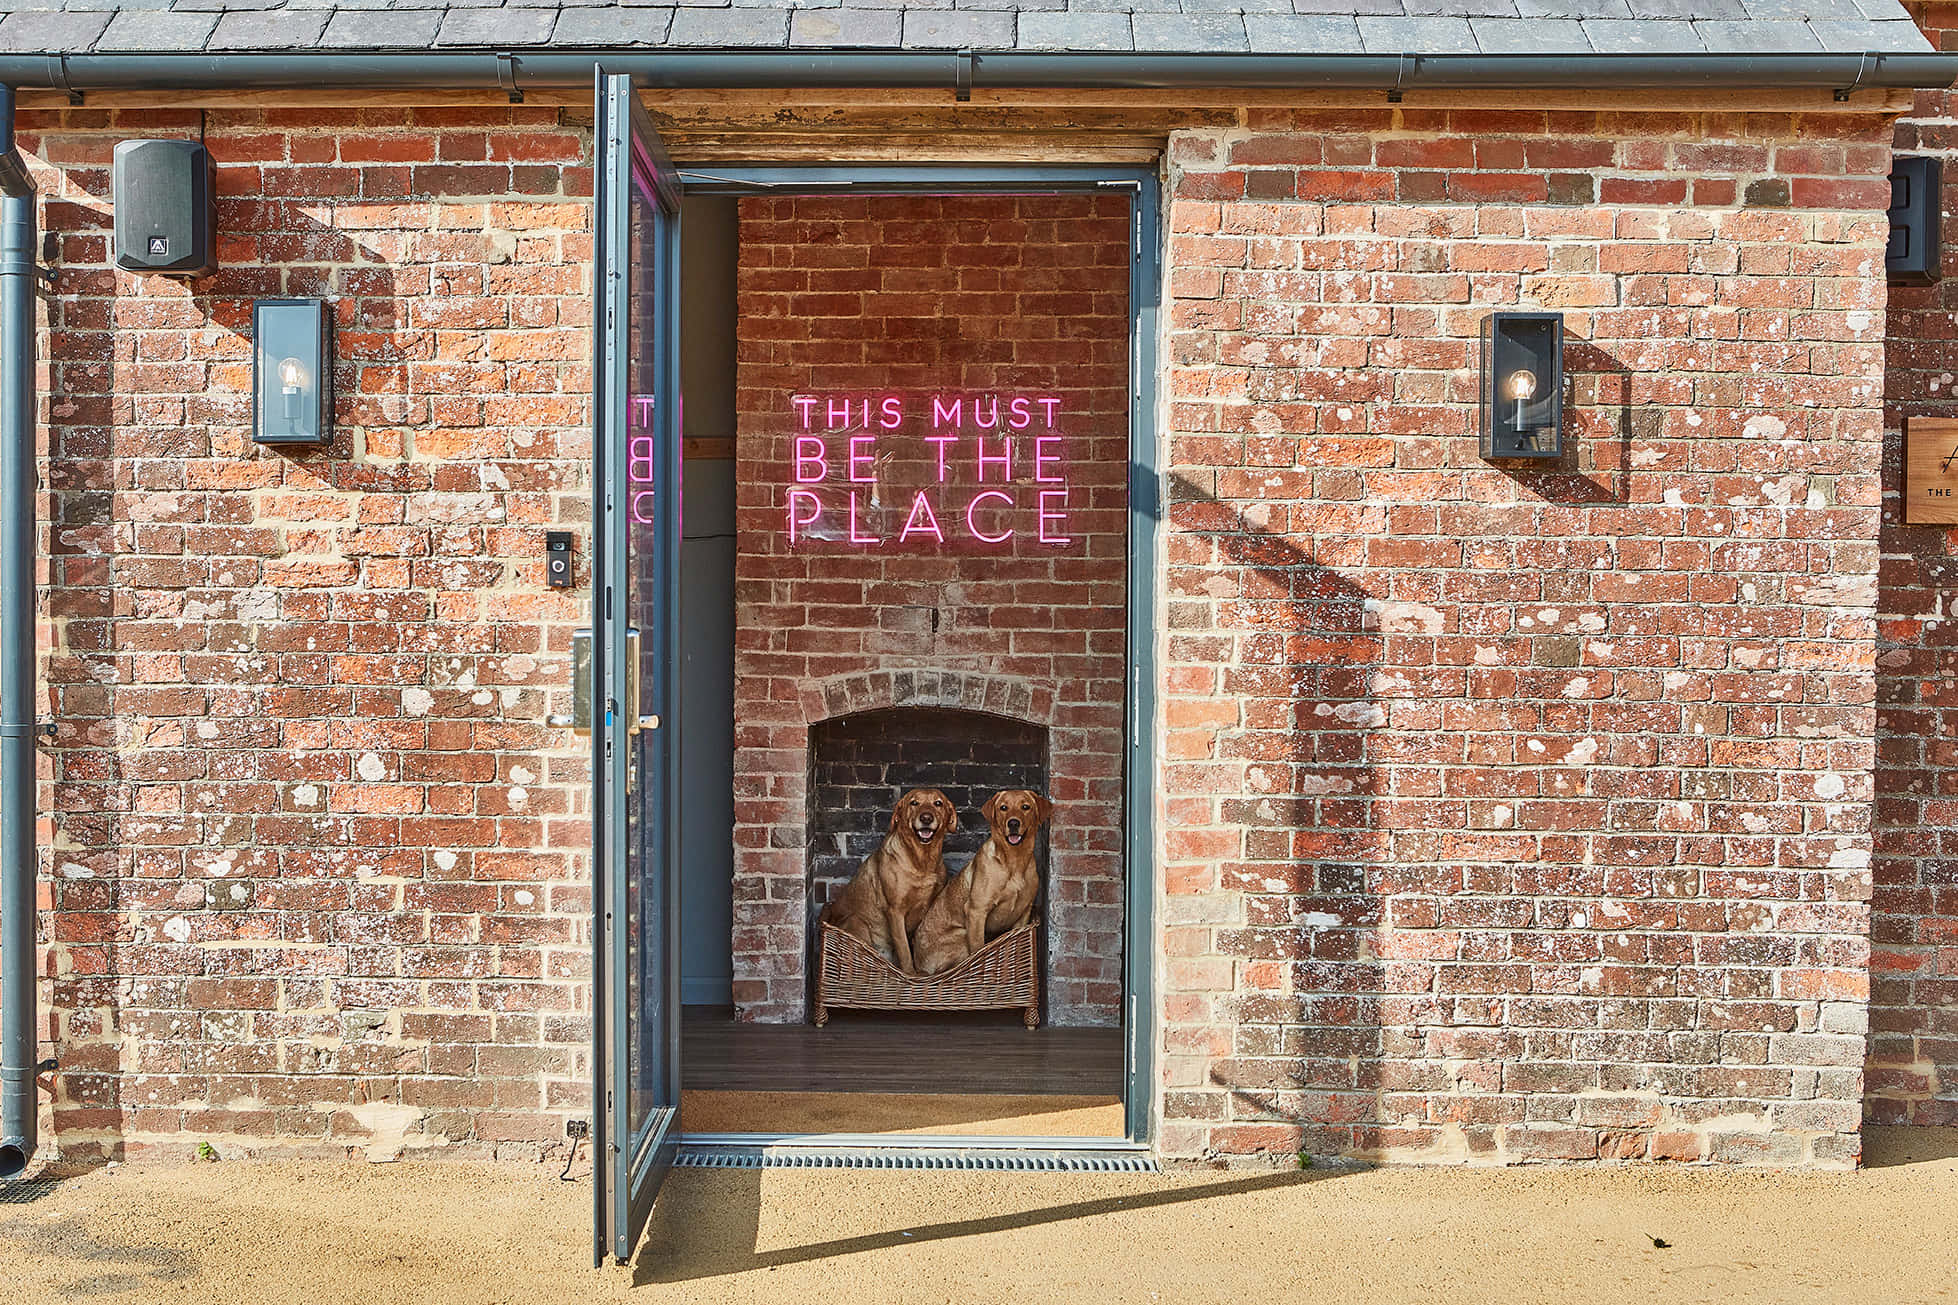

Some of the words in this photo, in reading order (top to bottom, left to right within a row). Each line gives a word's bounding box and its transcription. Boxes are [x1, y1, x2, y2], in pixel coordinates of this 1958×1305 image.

[795, 398, 901, 428] THIS
[933, 398, 1061, 428] MUST
[795, 436, 878, 482] BE
[924, 436, 1065, 482] THE
[1927, 488, 1952, 497] THE
[789, 490, 1071, 543] PLACE
